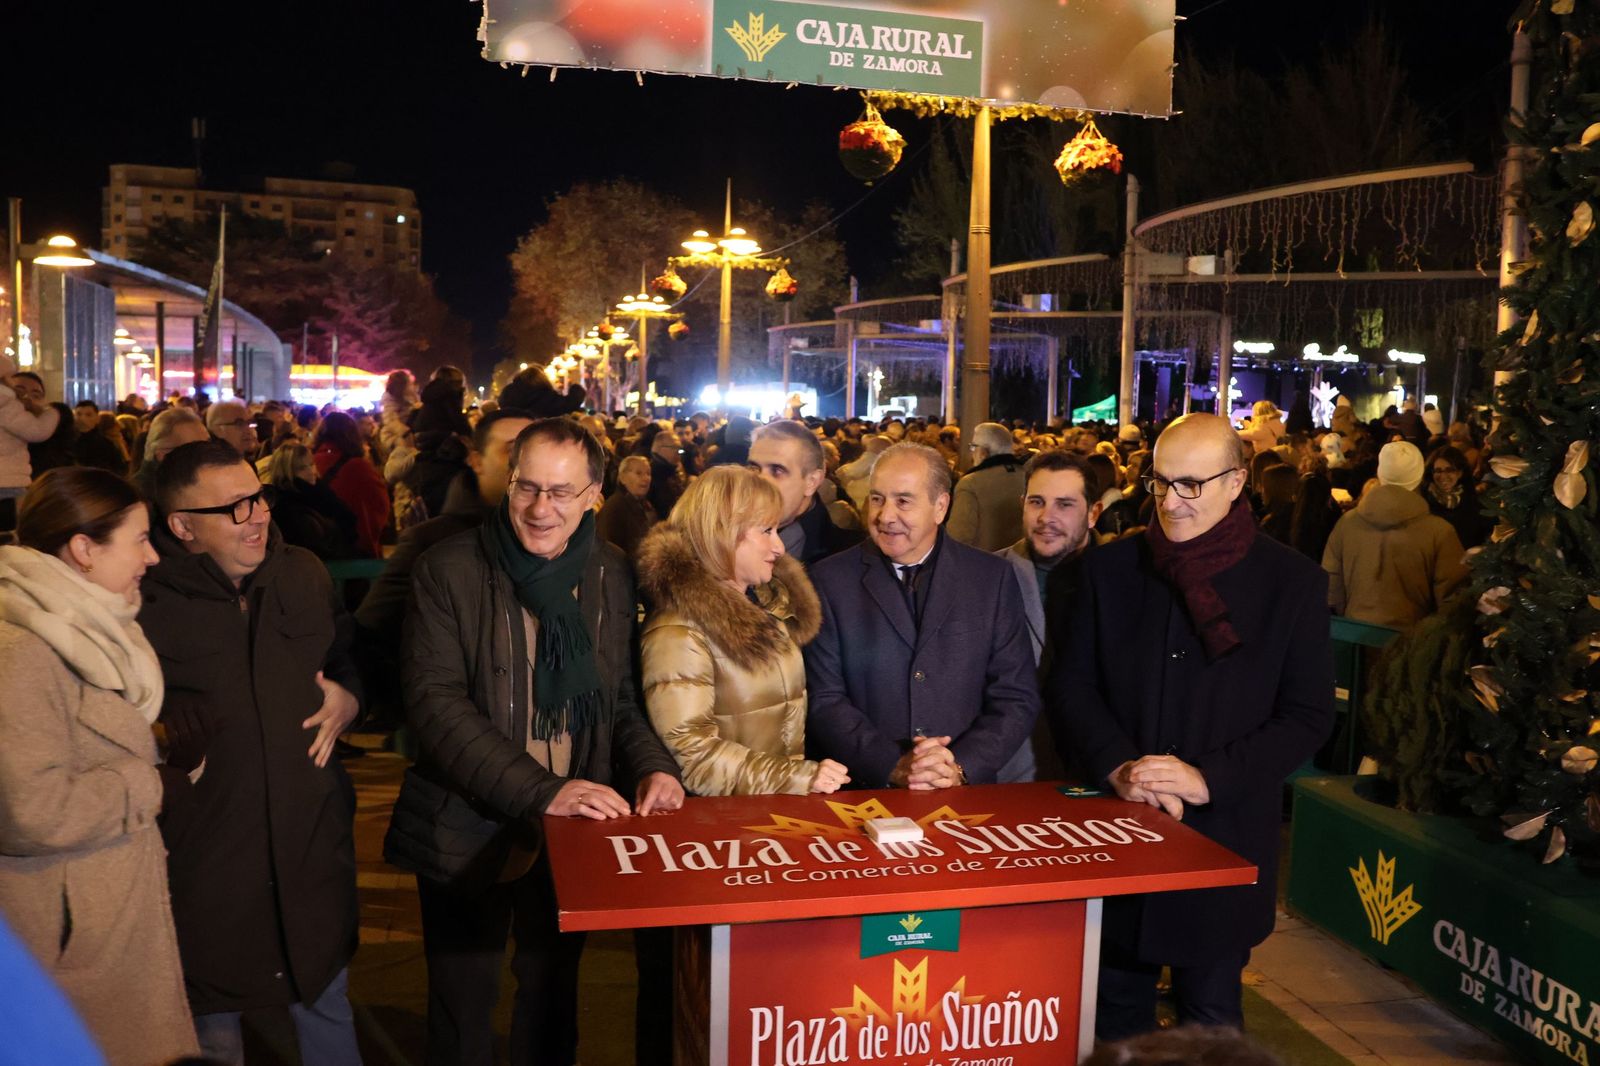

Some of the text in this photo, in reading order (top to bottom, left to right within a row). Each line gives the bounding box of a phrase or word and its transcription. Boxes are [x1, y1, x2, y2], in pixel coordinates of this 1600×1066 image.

[796, 19, 972, 59] CAJA RURAL
[829, 51, 943, 76] DE ZAMORA
[604, 834, 800, 875] Plaza
[807, 836, 869, 864] de
[933, 816, 1164, 855] Sueños
[723, 851, 1114, 886] del Comercio de Zamora
[1433, 920, 1600, 1044] CAJA RURA
[749, 991, 1060, 1066] Plaza de los Sueños
[1460, 972, 1590, 1066] DE ZAMORA
